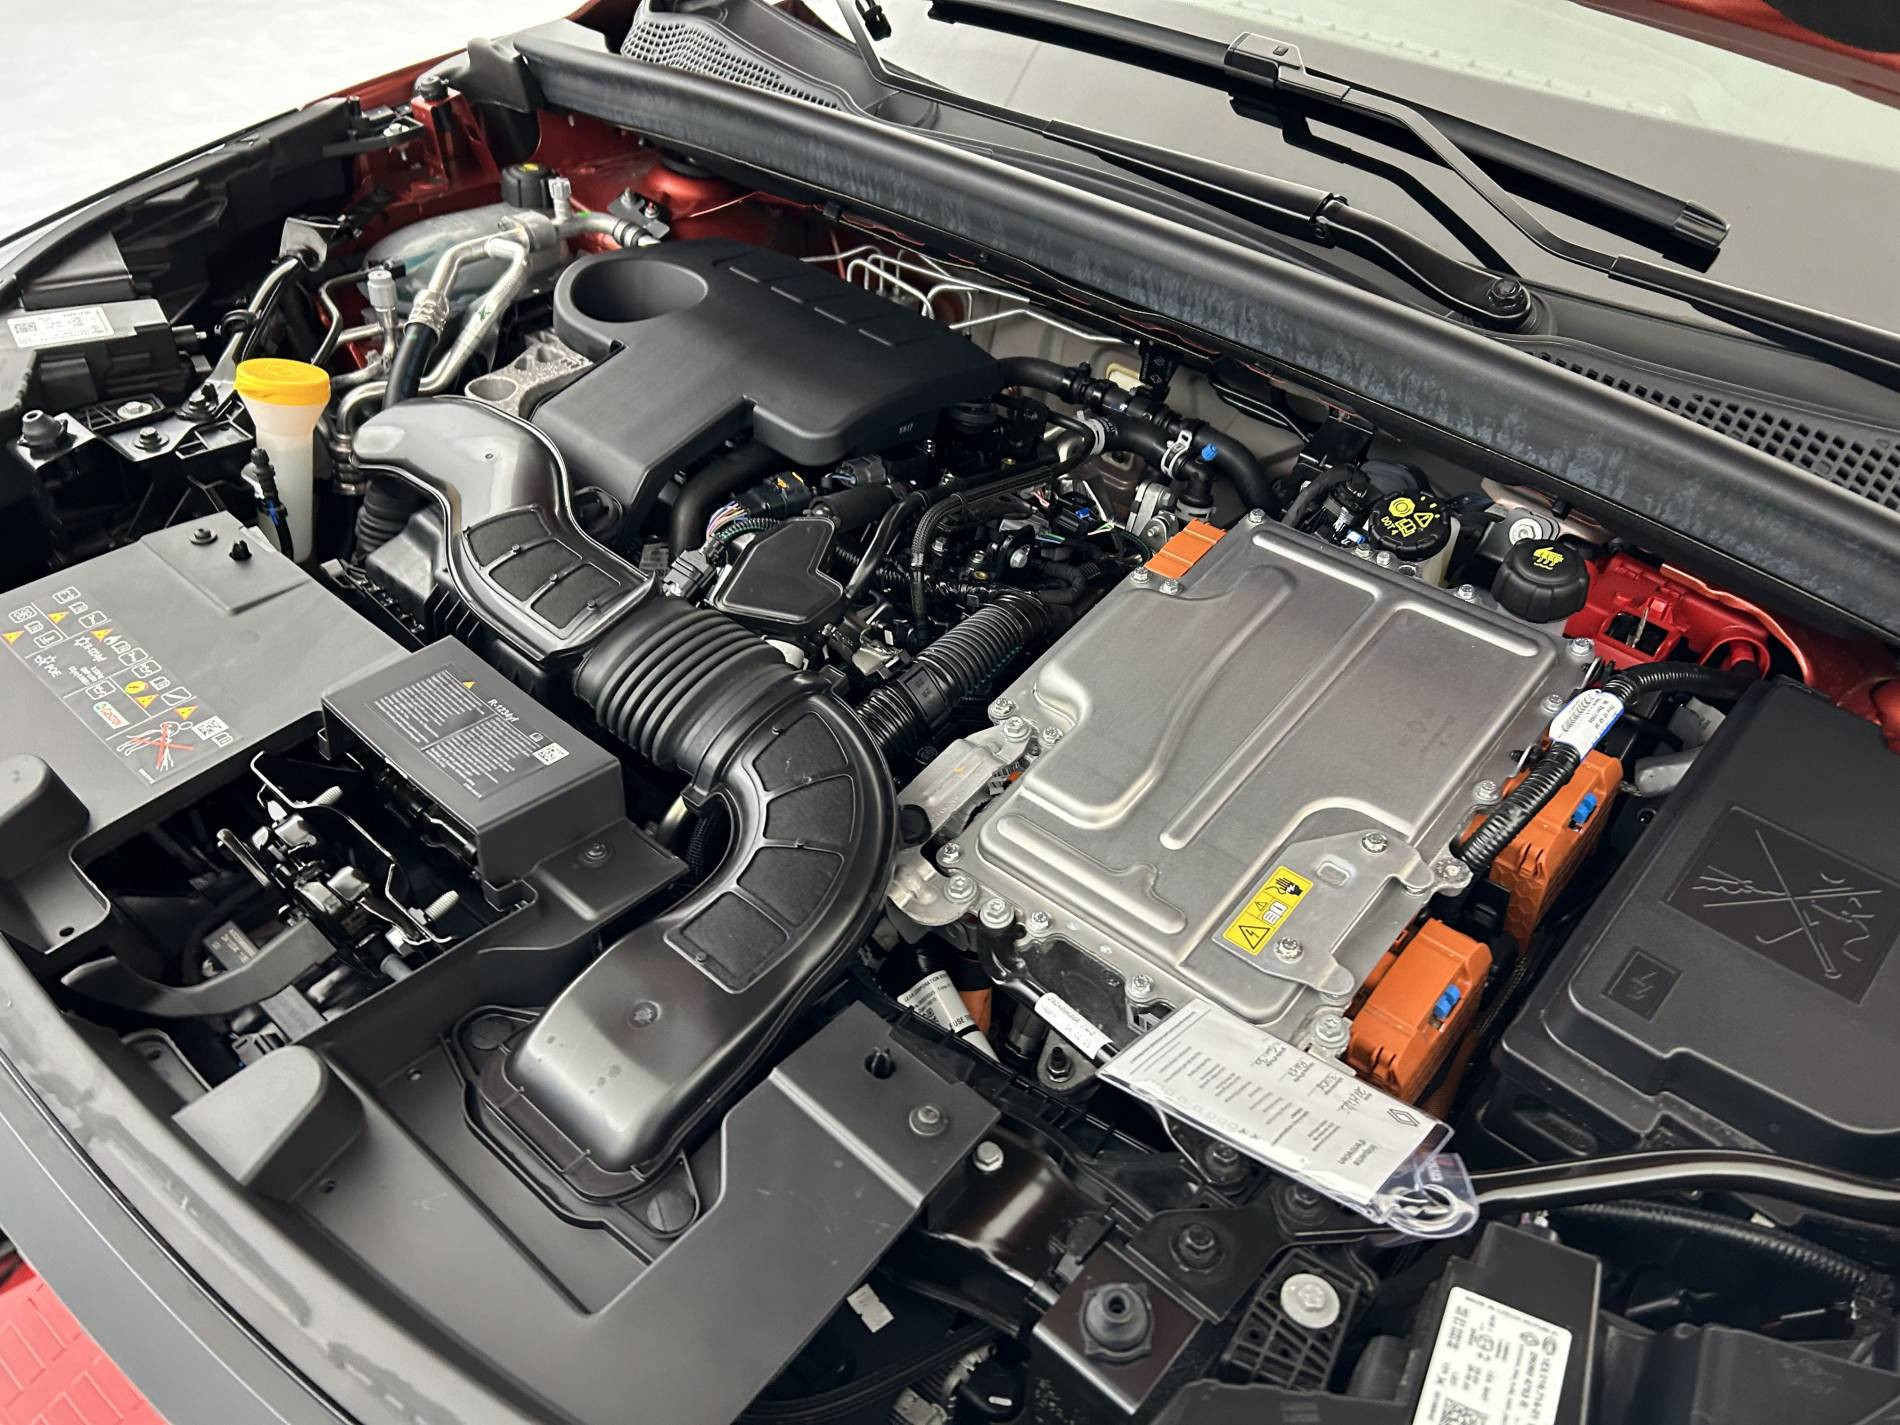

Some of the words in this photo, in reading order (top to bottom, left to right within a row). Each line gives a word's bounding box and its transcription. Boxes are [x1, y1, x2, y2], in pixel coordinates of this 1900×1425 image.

[1381, 516, 1396, 530] DOT
[44, 663, 62, 678] POE
[487, 698, 520, 723] R-1234yf
